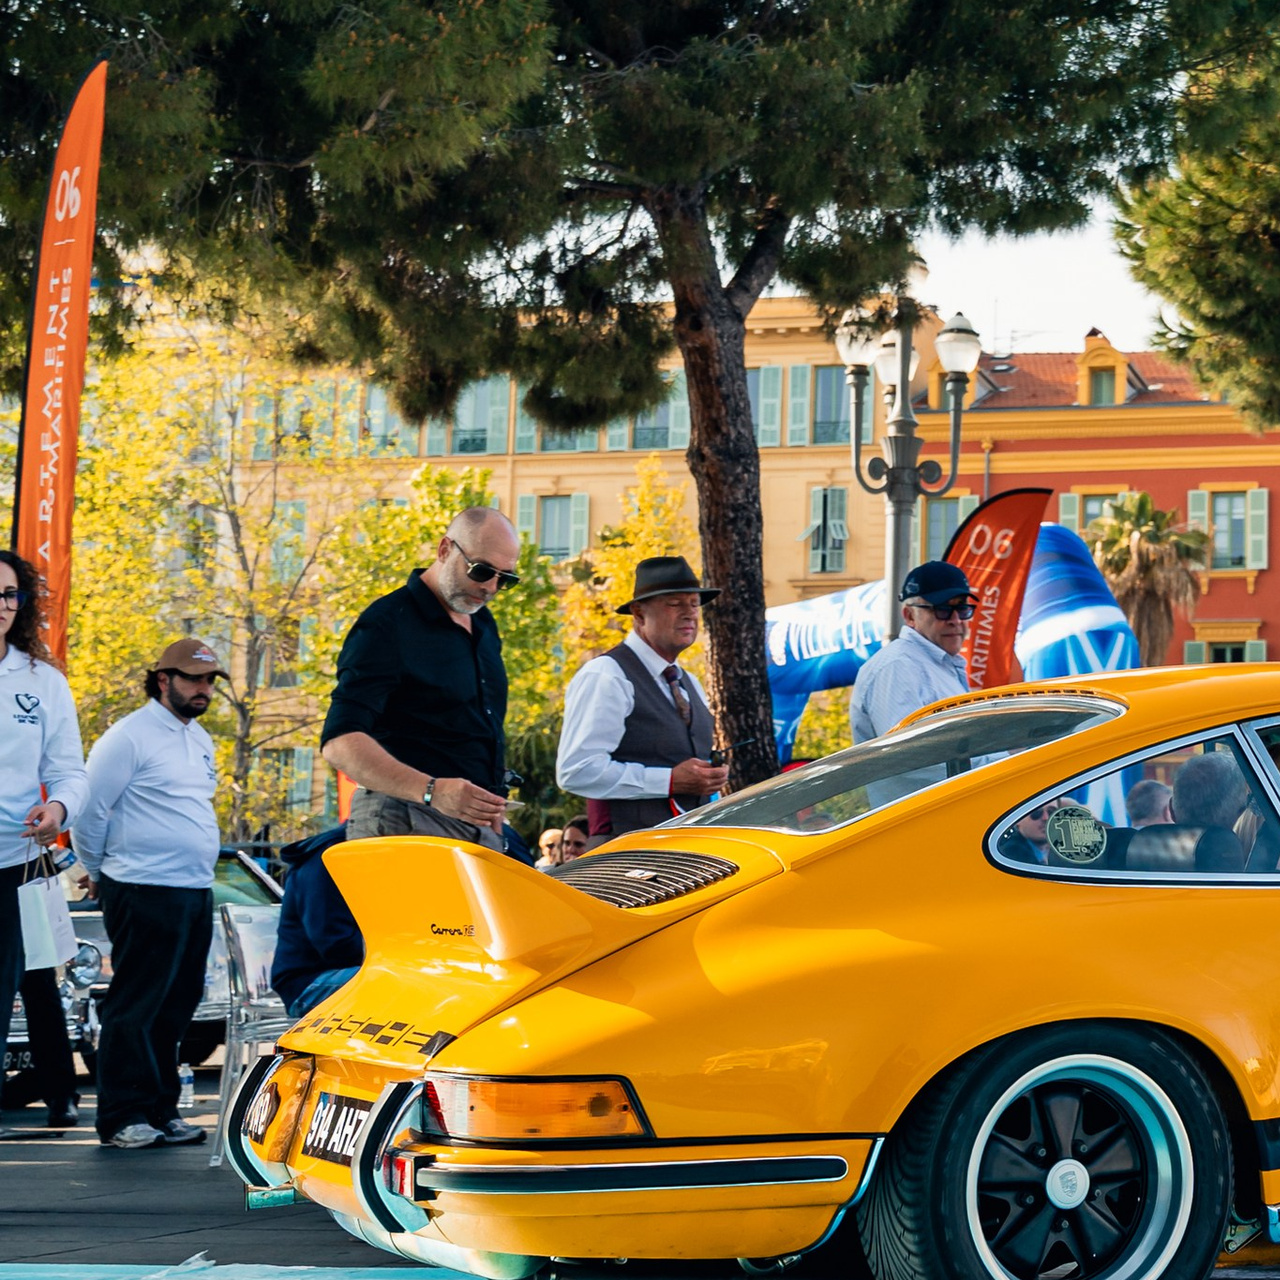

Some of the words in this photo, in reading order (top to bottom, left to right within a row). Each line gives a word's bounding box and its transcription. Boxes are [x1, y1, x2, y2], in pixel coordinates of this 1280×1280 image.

[55, 166, 82, 222] 06
[968, 523, 1015, 560] 06
[969, 585, 1000, 692] ARITIMES
[430, 923, 463, 936] Carrera
[305, 1101, 337, 1149] 914
